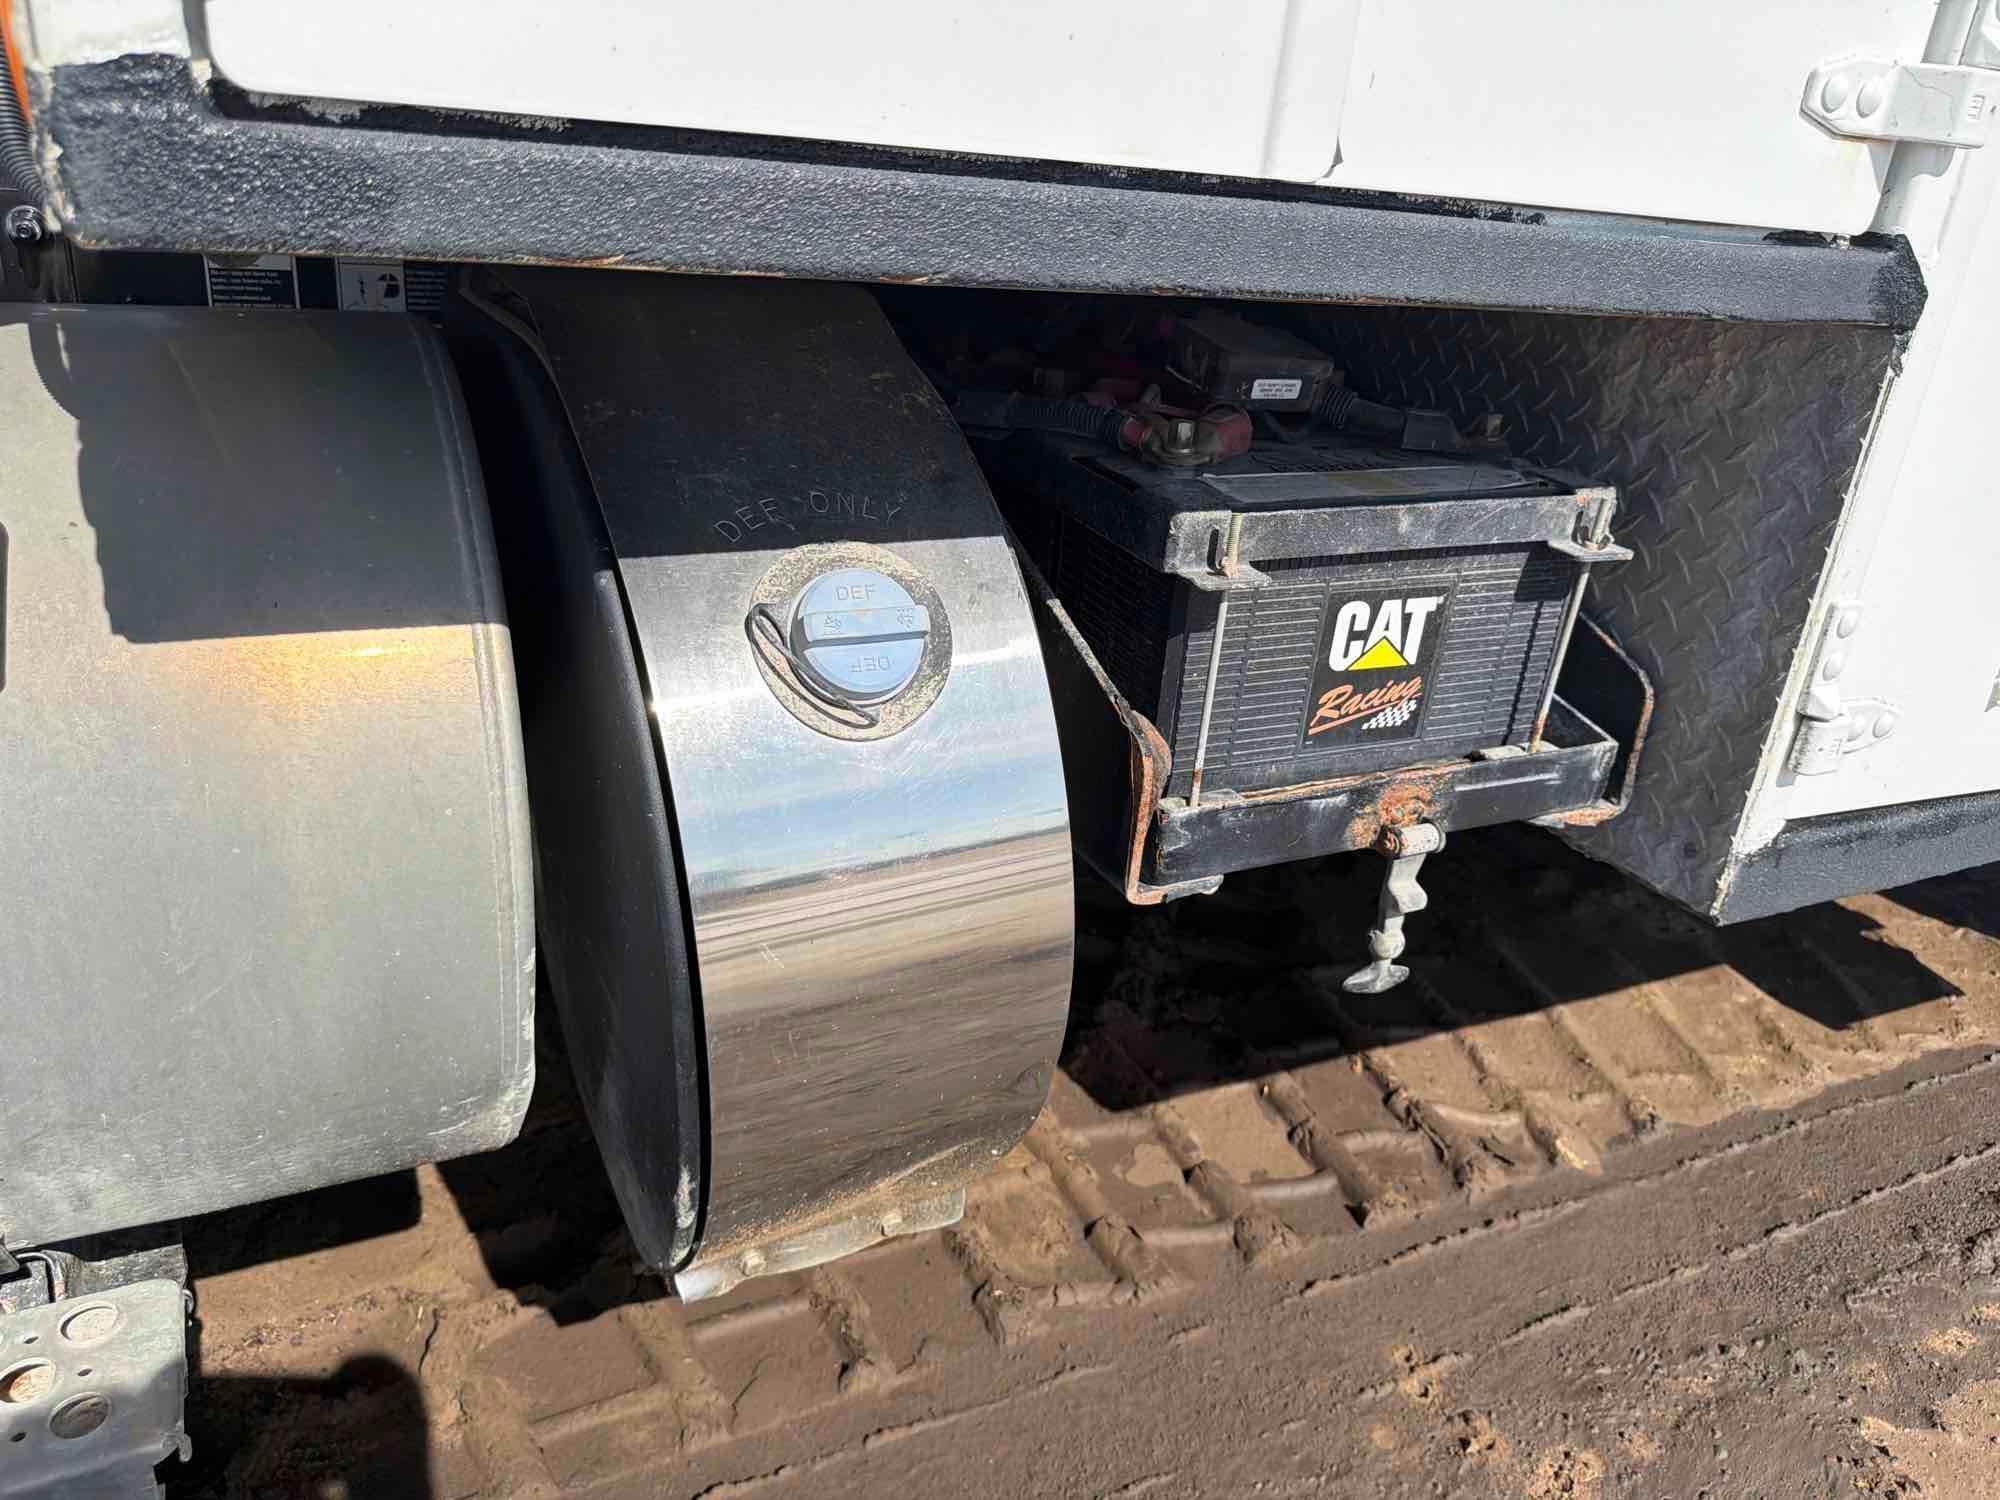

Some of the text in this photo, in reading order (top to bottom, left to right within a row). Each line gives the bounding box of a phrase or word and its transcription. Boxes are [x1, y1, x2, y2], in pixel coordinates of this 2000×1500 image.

[713, 488, 906, 543] DEF ONLY
[835, 584, 877, 601] DEF
[1329, 595, 1441, 672] CAT
[850, 656, 891, 673] DEF
[1309, 676, 1423, 730] Racing
